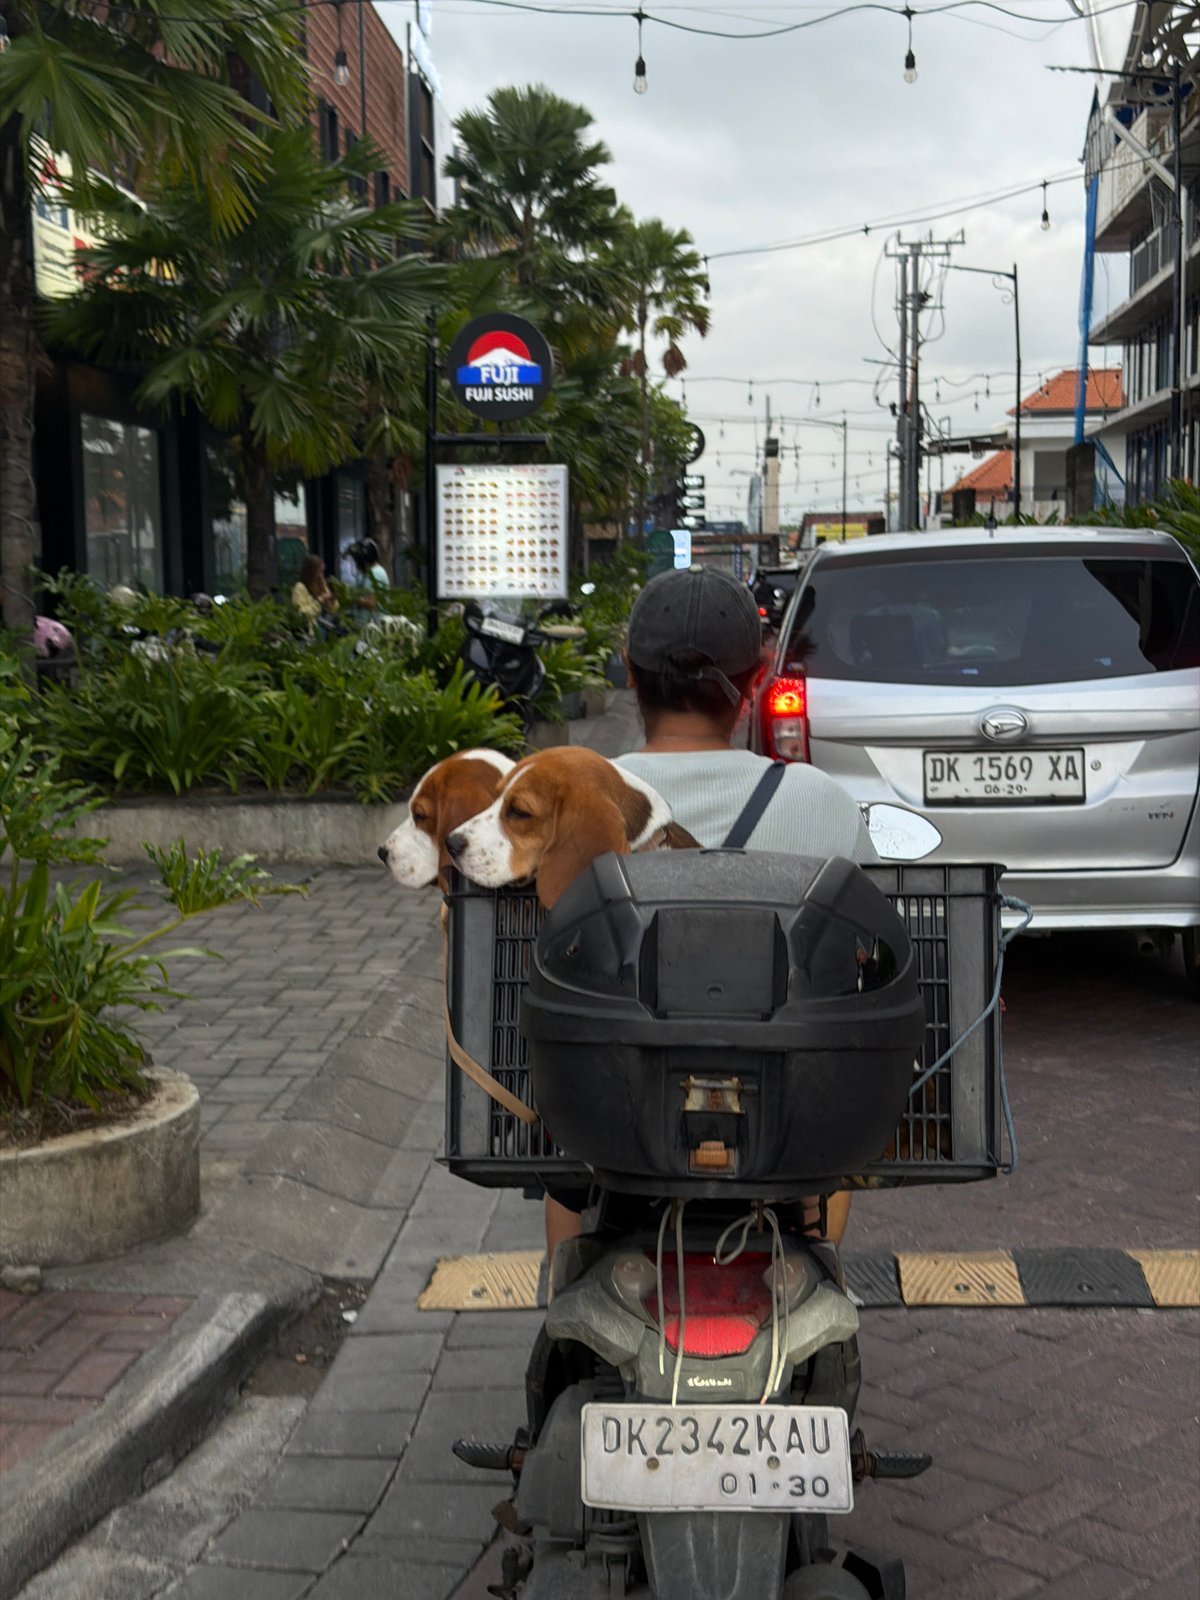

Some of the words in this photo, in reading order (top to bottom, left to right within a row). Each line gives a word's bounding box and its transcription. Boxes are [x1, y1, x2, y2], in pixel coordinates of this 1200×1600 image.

[480, 366, 519, 386] FUJI
[465, 387, 493, 402] FUJI
[494, 387, 534, 402] SUSHI
[930, 757, 960, 783] DK
[973, 756, 1034, 782] 1569
[1049, 755, 1079, 781] XA
